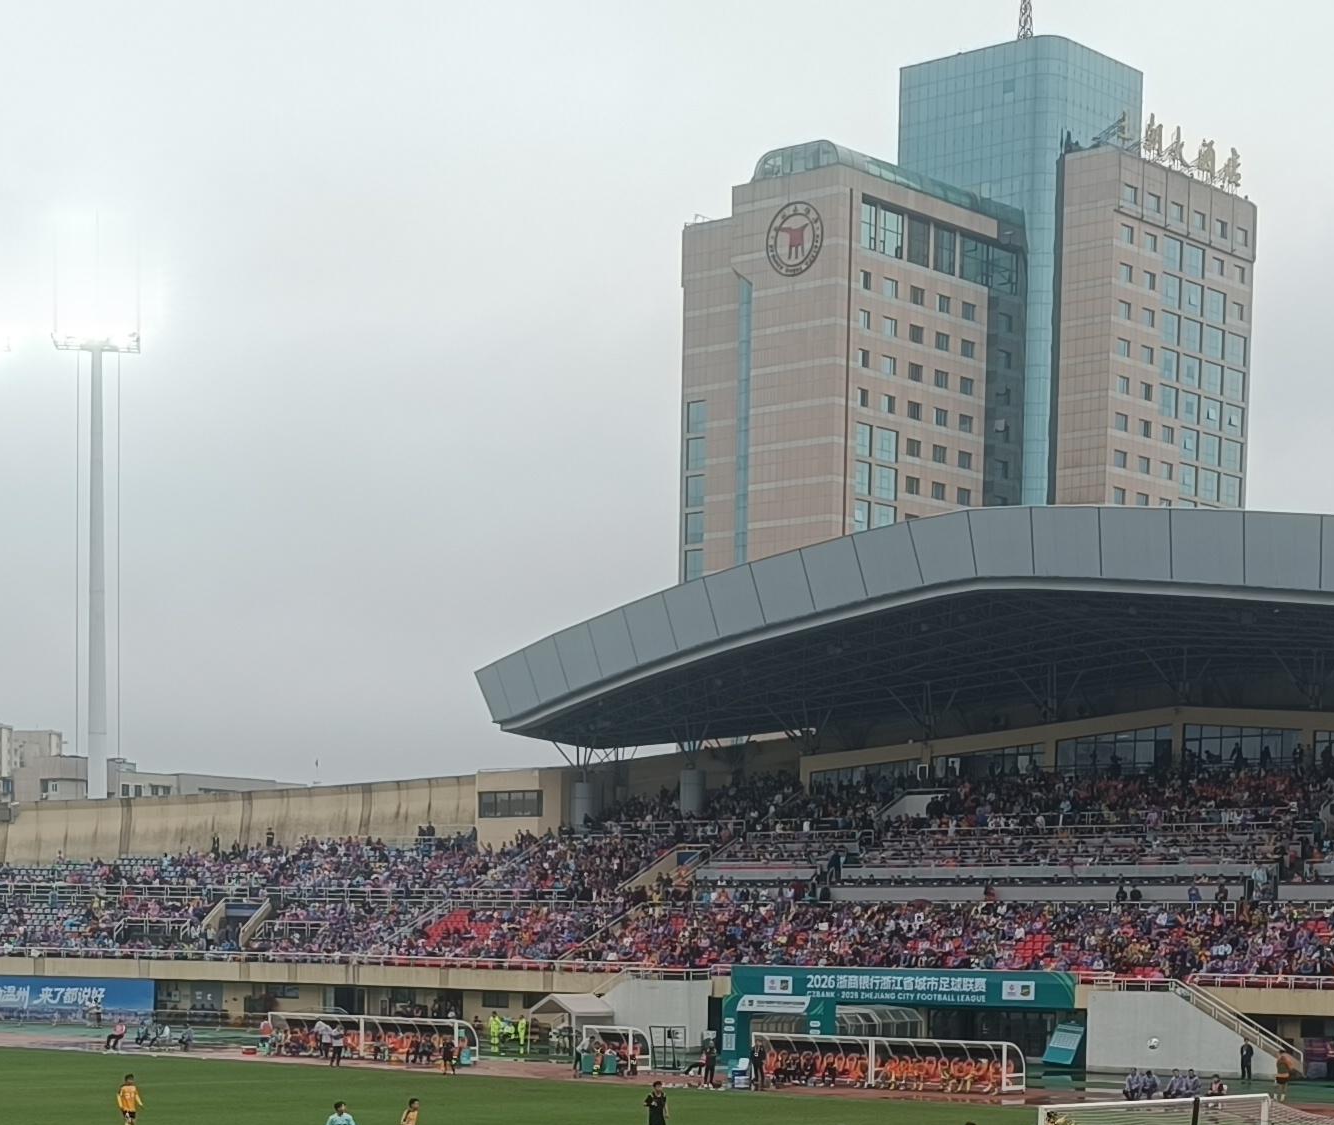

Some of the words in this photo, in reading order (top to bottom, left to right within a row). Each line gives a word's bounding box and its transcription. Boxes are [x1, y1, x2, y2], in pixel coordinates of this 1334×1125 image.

[33, 986, 106, 1005] 来了都说好
[860, 992, 896, 1000] ZHEJIANG
[917, 993, 955, 1002] FOOTBALL
[956, 995, 986, 1003] LEAGUE
